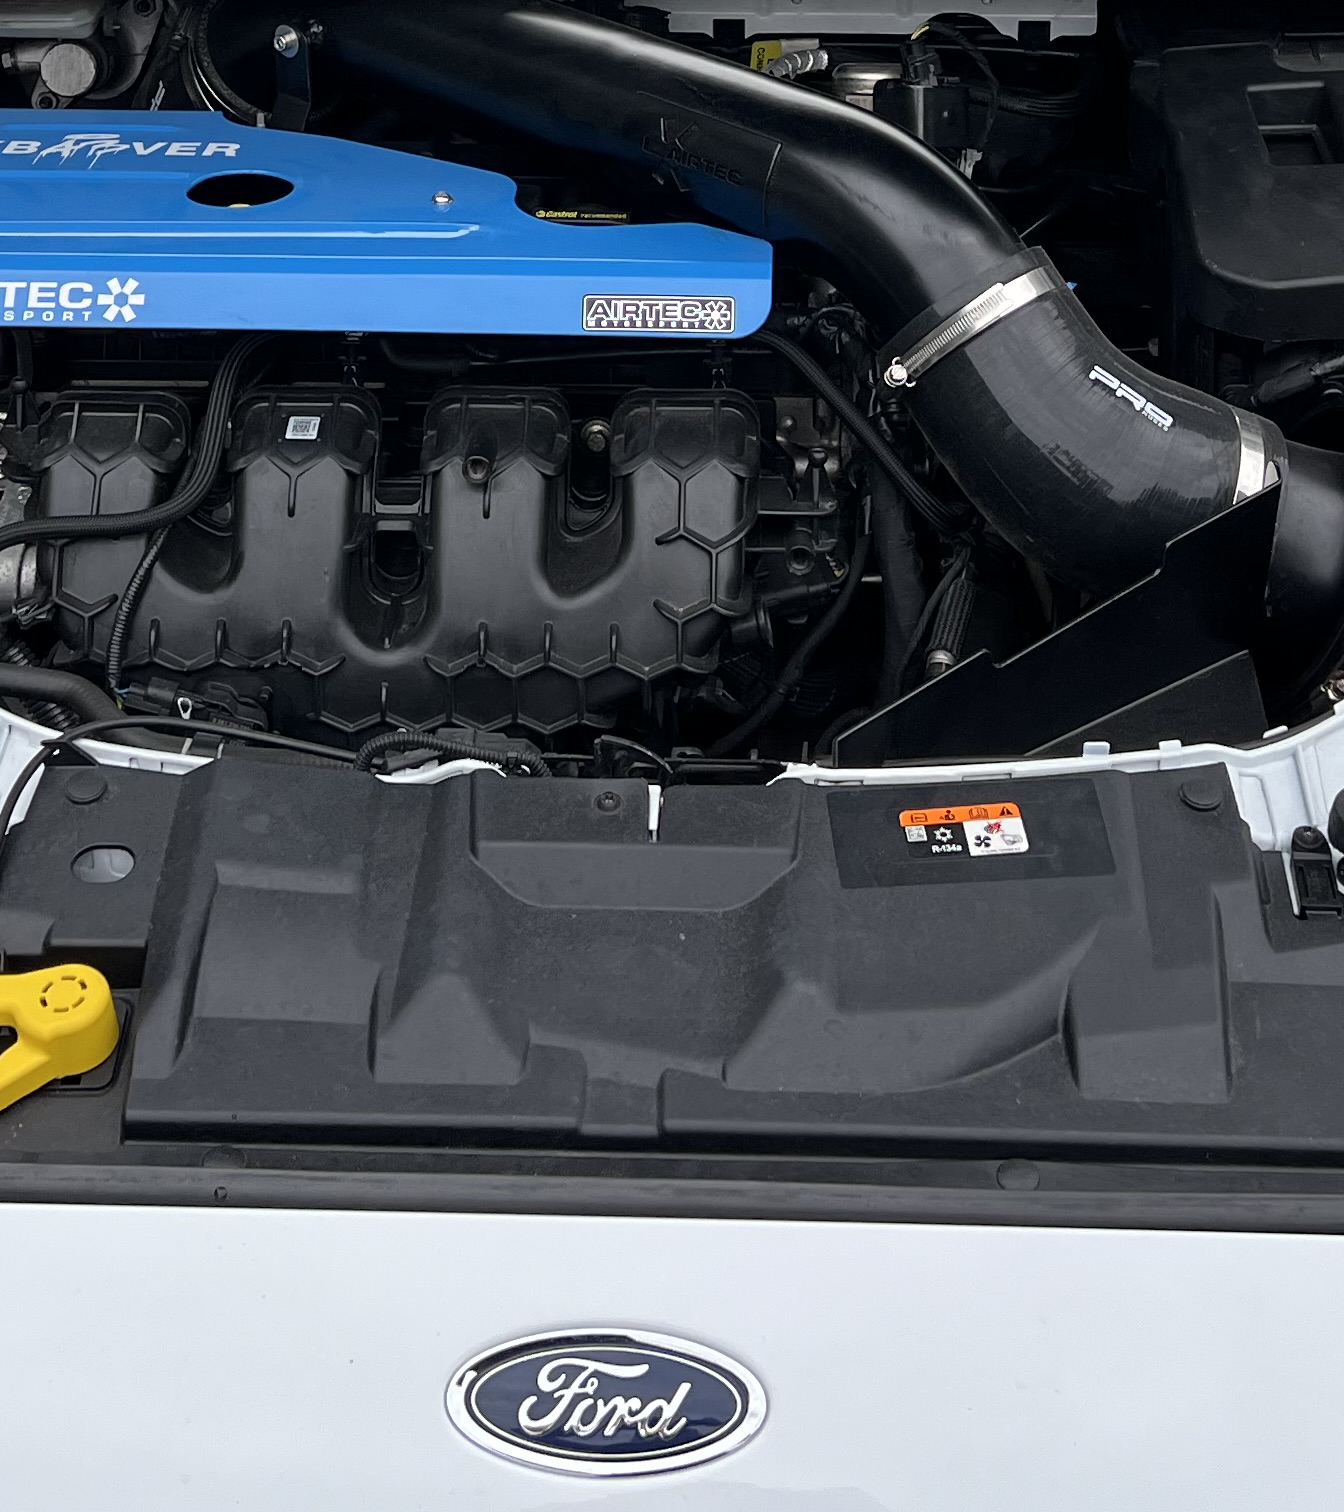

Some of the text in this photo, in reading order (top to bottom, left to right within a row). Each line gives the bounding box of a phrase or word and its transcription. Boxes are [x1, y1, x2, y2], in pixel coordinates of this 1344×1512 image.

[587, 299, 703, 322] AIRTEC
[1088, 364, 1174, 428] PRO
[518, 1357, 692, 1439] Ford
